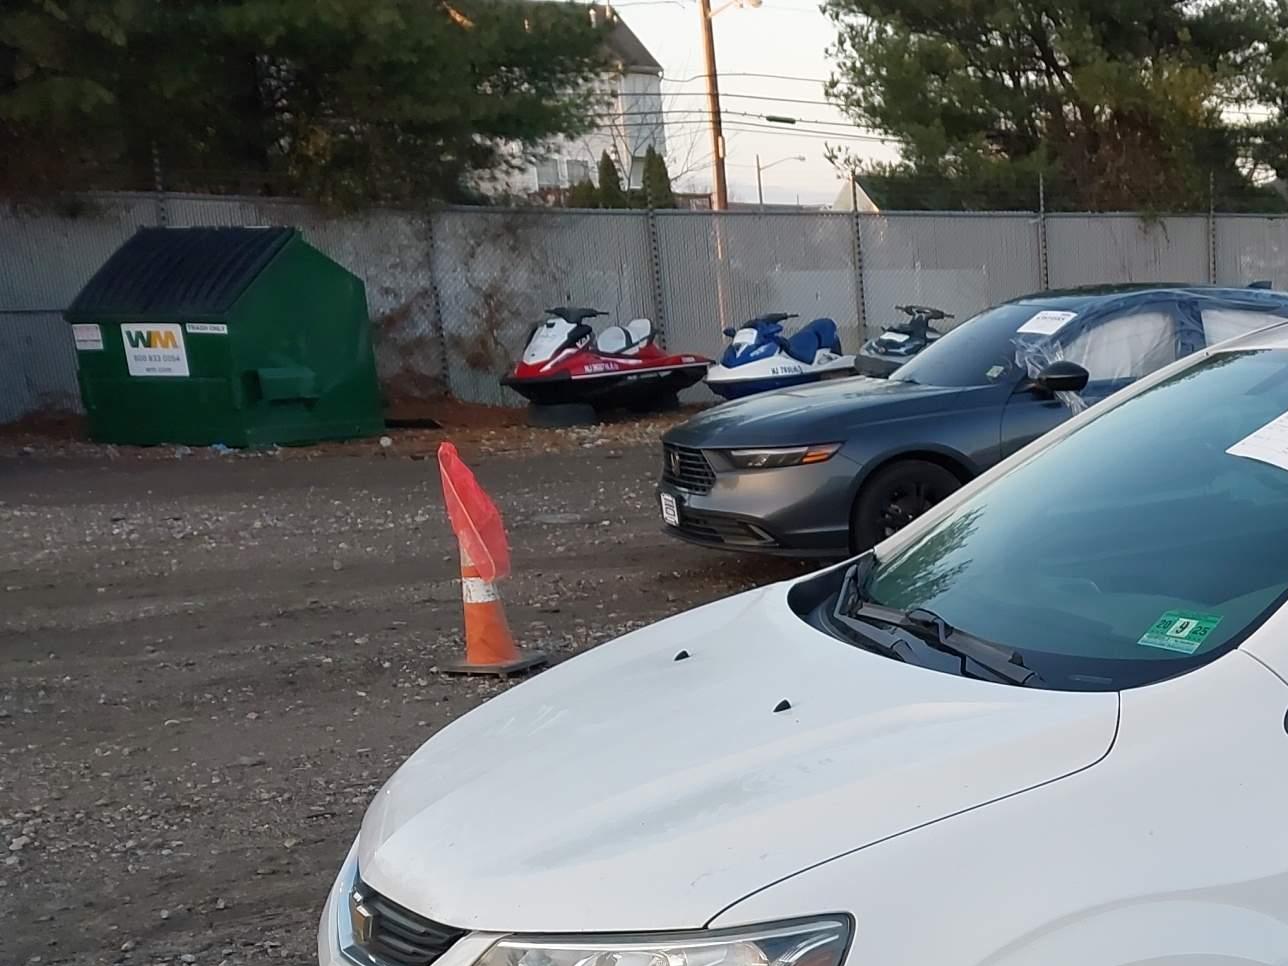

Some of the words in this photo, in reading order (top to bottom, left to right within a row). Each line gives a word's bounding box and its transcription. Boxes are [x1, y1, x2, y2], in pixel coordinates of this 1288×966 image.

[126, 330, 178, 348] WM
[1156, 619, 1173, 629] 20
[1176, 621, 1190, 634] 9
[1192, 626, 1210, 636] 25
